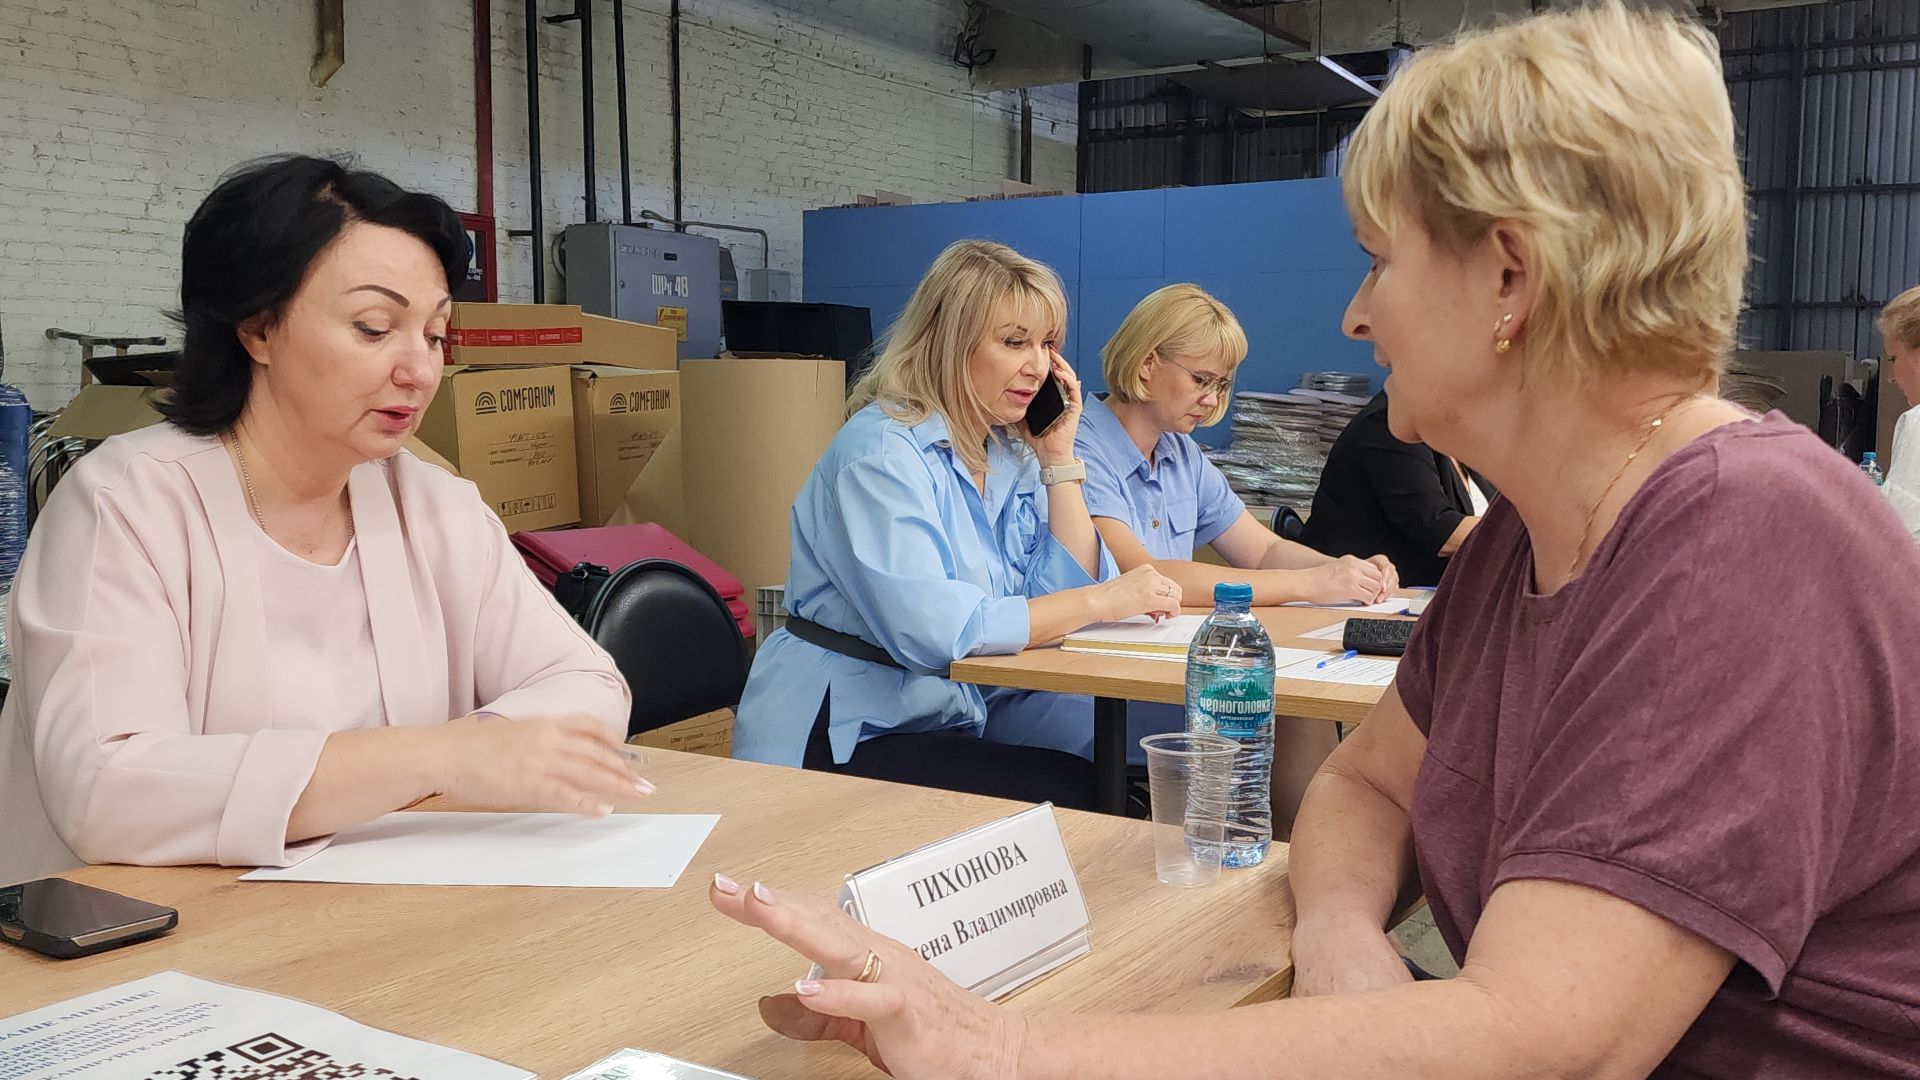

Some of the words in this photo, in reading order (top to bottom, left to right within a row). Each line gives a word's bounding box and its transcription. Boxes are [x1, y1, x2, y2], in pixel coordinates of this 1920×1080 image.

[674, 275, 689, 298] 48
[500, 384, 556, 412] COMFORUM
[629, 389, 671, 413] COMFORUM
[907, 840, 1028, 909] ТИХОНОВА
[913, 933, 953, 962] ена
[951, 878, 1068, 946] Владимировна
[58, 990, 160, 1021] МНЕНИЕ!
[0, 1023, 119, 1062] ЕРЕШЕННЫМ
[9, 1027, 84, 1051] ВОПРОС
[82, 1003, 161, 1028] ОСТАЛСЯ
[0, 1046, 65, 1068] ОТИТЕ
[40, 1045, 151, 1080] КАНИРУЙТЕ
